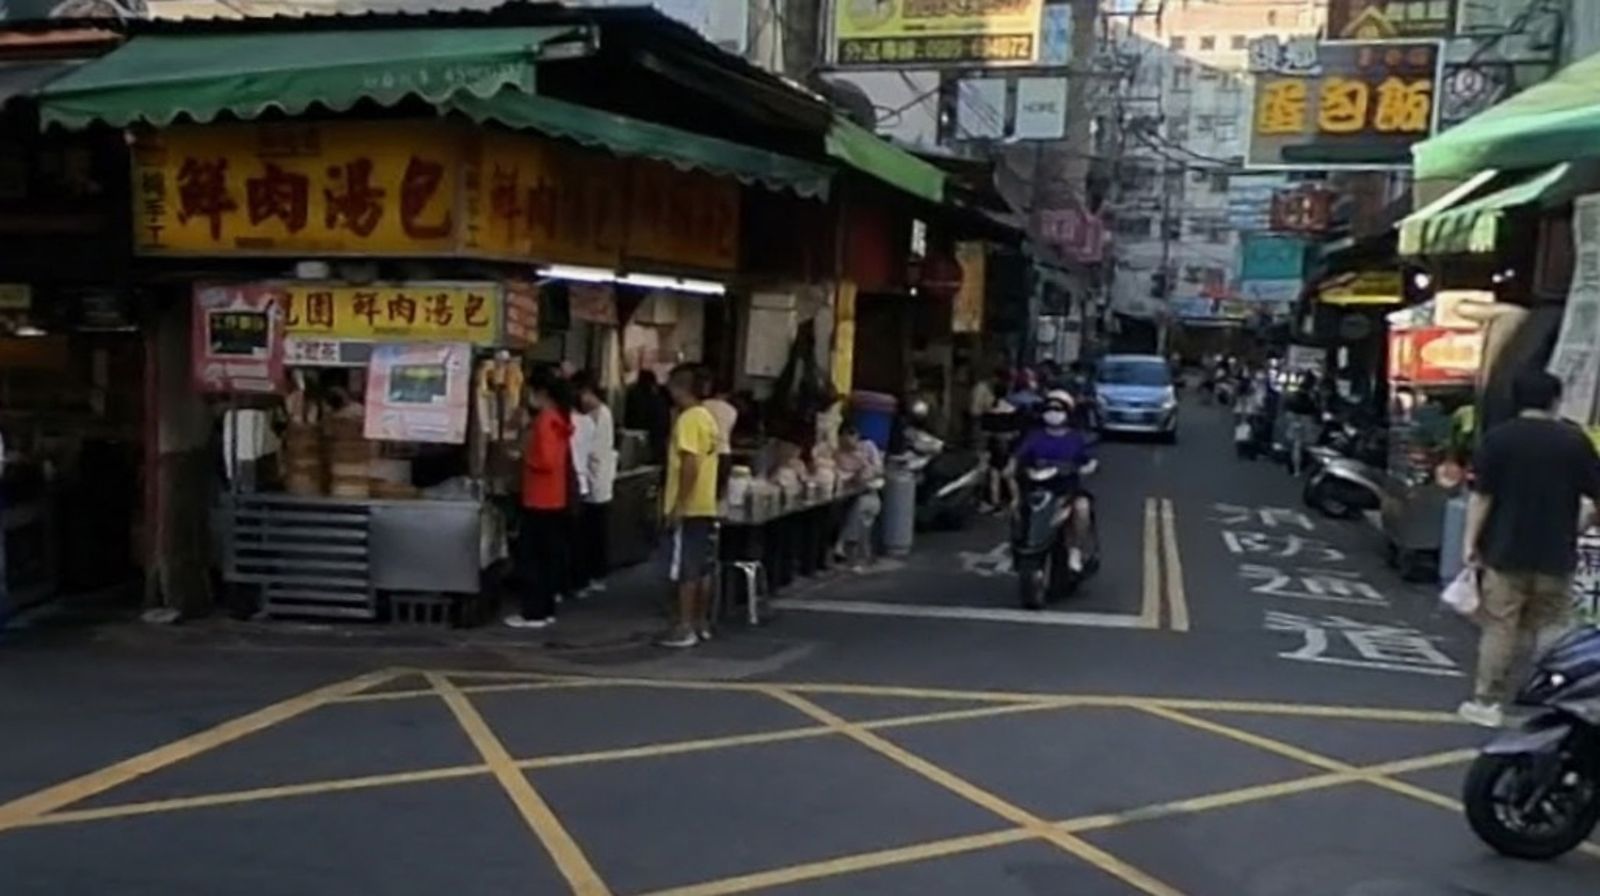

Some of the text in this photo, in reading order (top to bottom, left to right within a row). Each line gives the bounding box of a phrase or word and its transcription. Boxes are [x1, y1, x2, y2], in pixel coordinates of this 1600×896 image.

[178, 156, 452, 240] 鮮肉湯包
[352, 291, 489, 327] 鮮肉湯包
